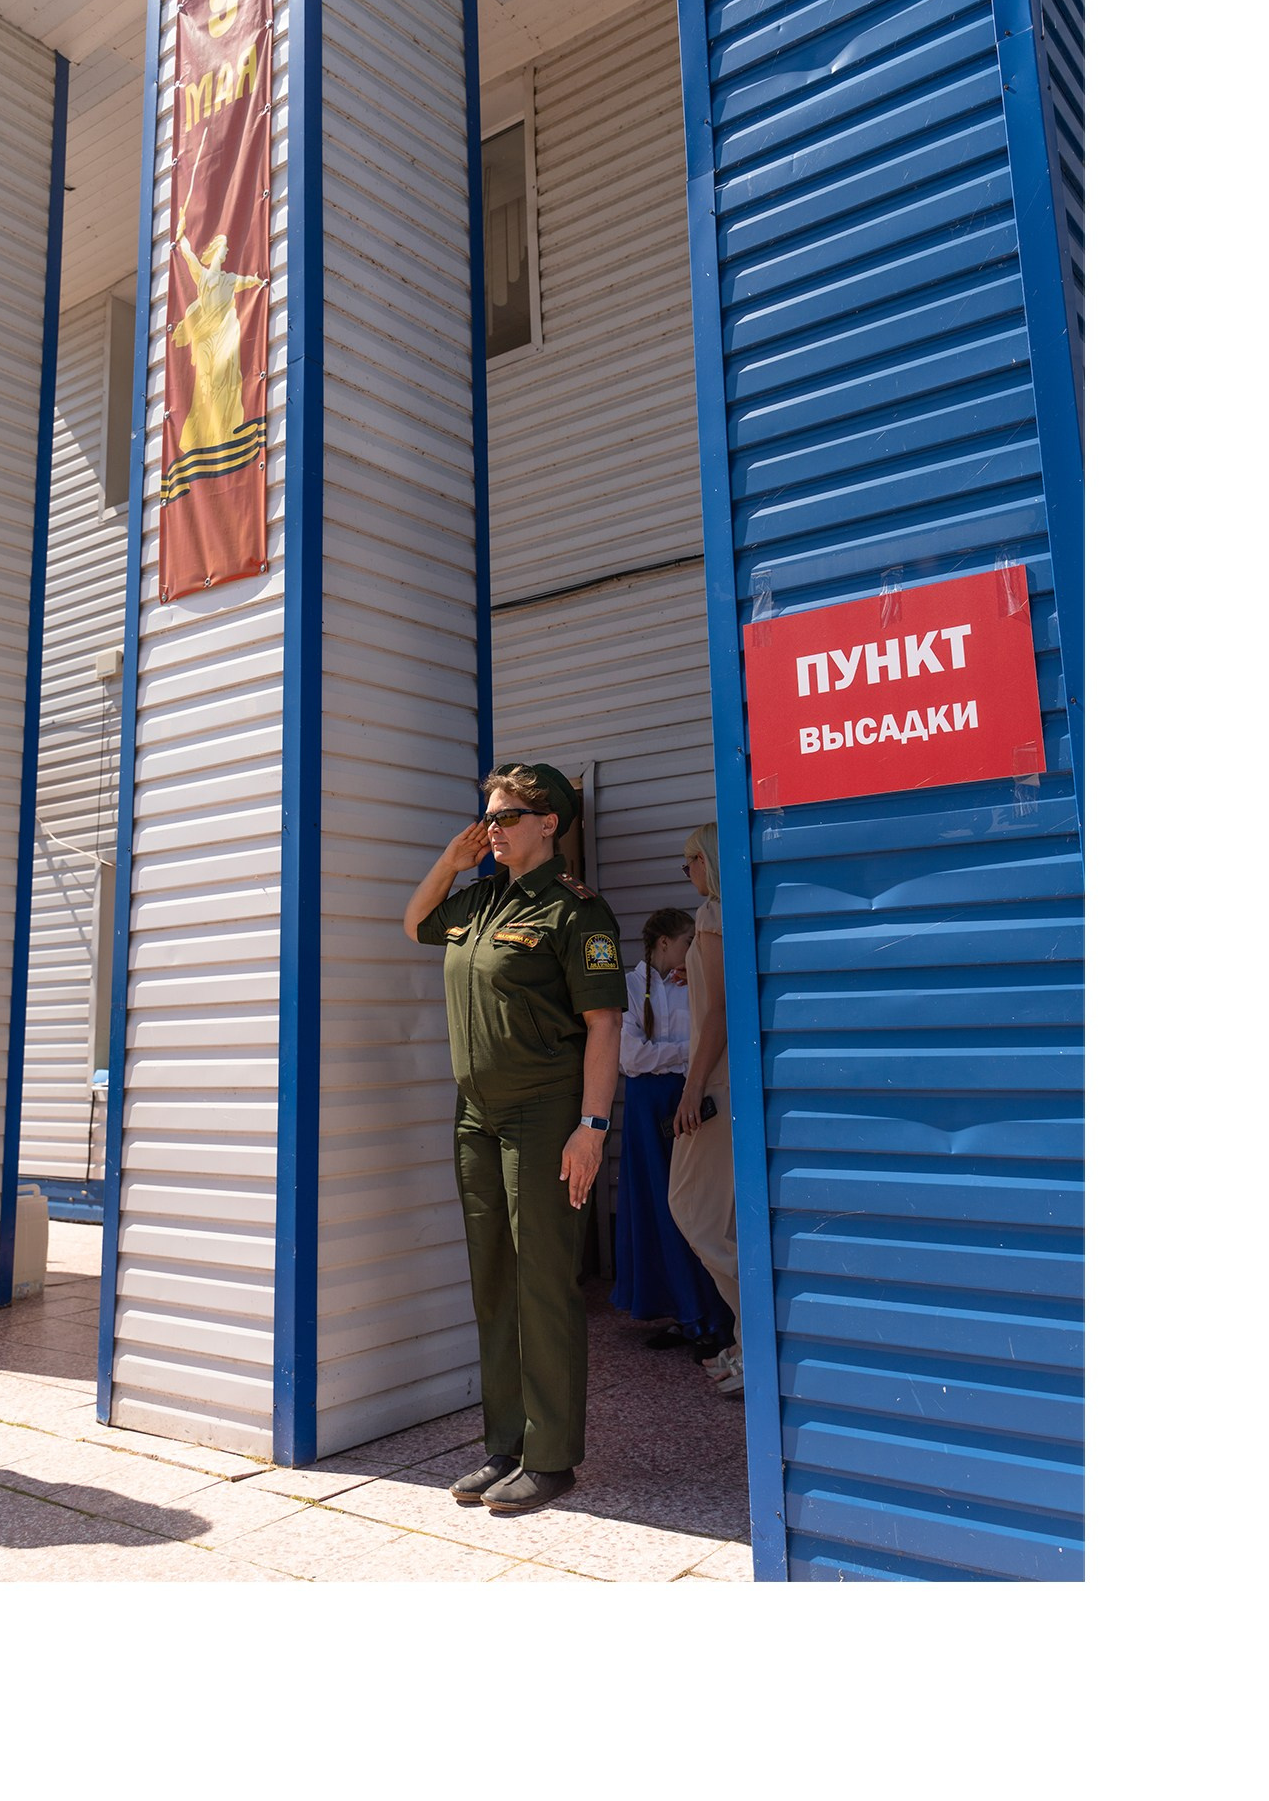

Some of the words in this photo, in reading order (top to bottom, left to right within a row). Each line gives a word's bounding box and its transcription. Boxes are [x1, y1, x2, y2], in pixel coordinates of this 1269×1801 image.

[185, 43, 258, 134] МАЯ
[795, 623, 972, 698] ПУНКТ
[798, 700, 979, 755] ВЫСАДКИ
